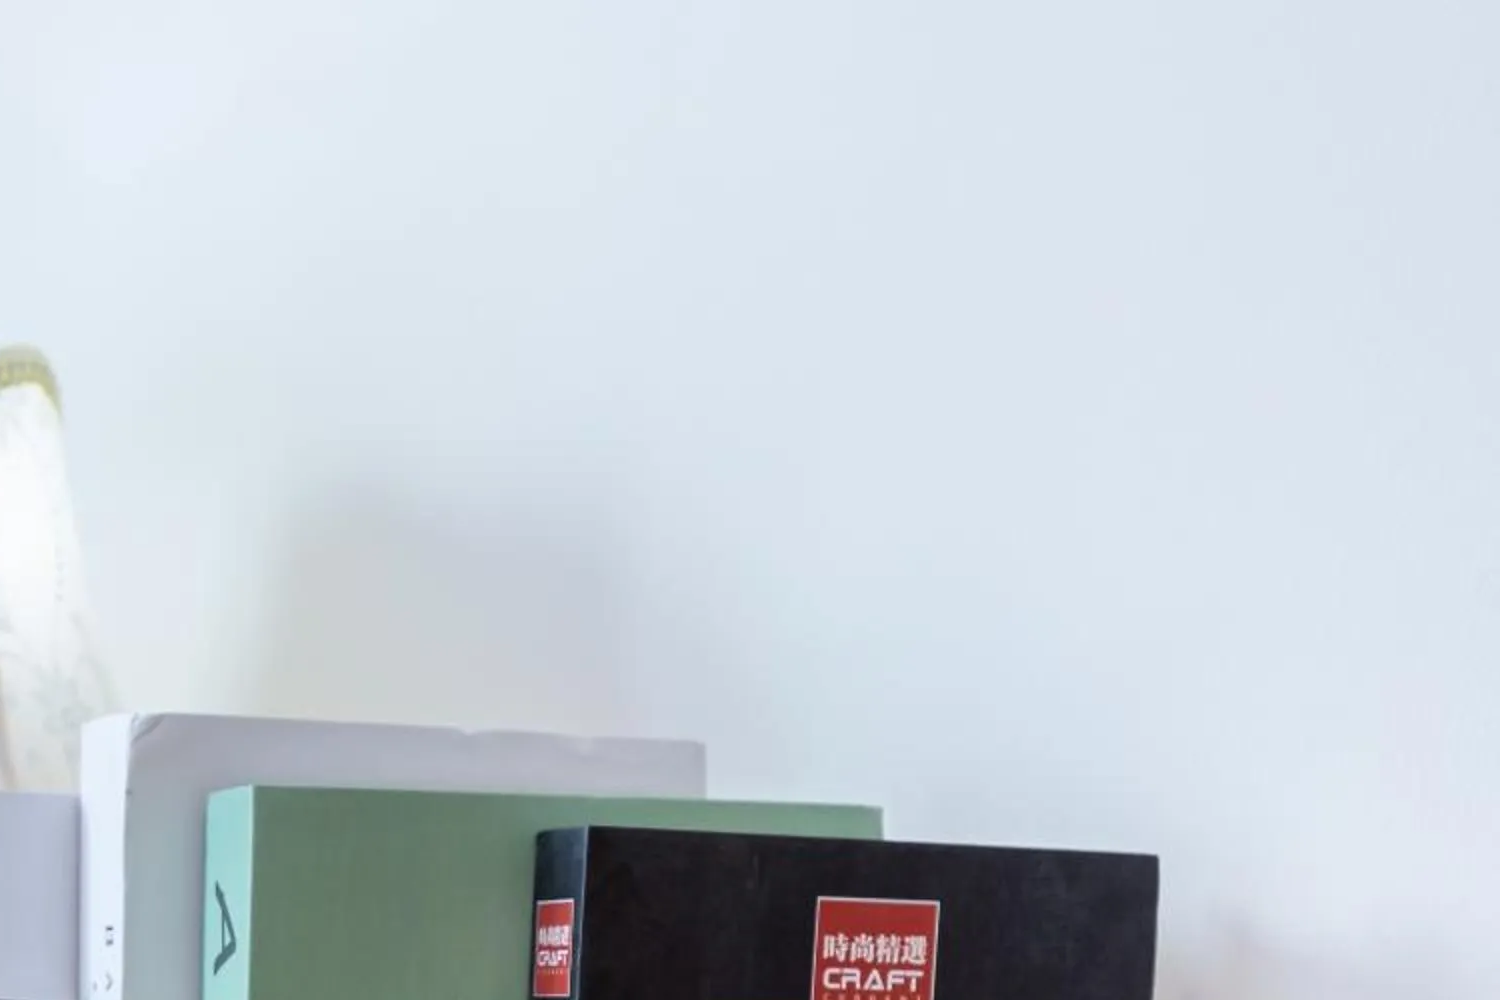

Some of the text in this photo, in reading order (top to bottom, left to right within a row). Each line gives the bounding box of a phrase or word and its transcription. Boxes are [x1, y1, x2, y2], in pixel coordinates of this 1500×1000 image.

[822, 933, 928, 965] 時尚精選
[822, 967, 924, 992] CRAFT
